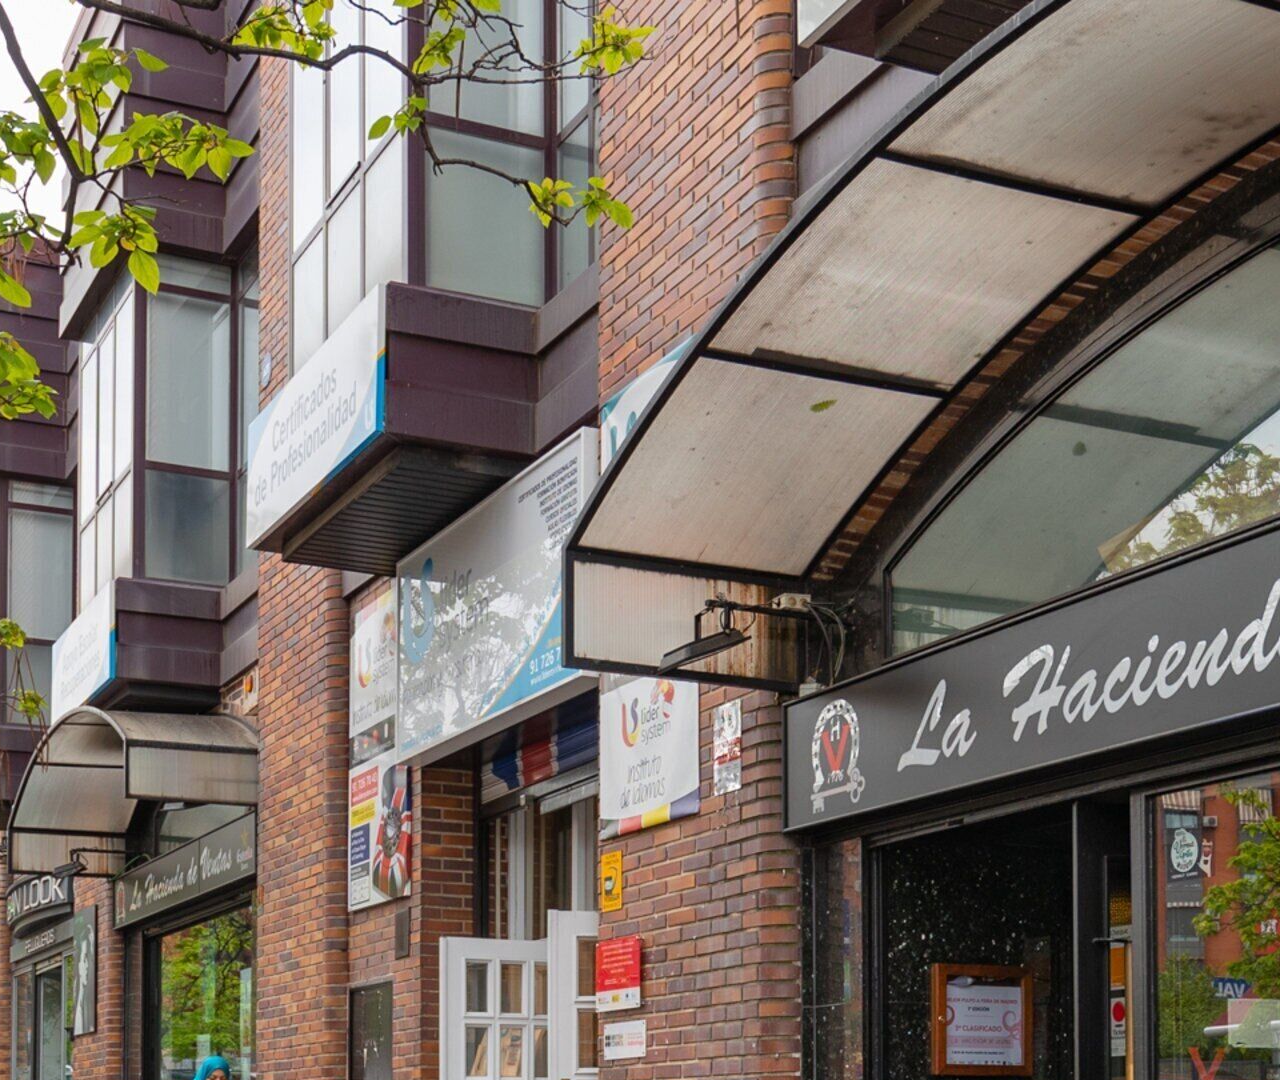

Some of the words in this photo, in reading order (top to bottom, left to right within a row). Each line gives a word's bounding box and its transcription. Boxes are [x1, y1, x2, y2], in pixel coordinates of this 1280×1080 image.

[272, 368, 337, 452] Certificados
[255, 478, 267, 507] de
[270, 380, 357, 493] Profesionalidad
[640, 720, 670, 746] system
[896, 678, 977, 773] La
[23, 874, 65, 912] LOOK
[144, 863, 185, 905] Hacienda
[200, 846, 233, 881] Ventas
[962, 1025, 1003, 1033] CLASIFICADO
